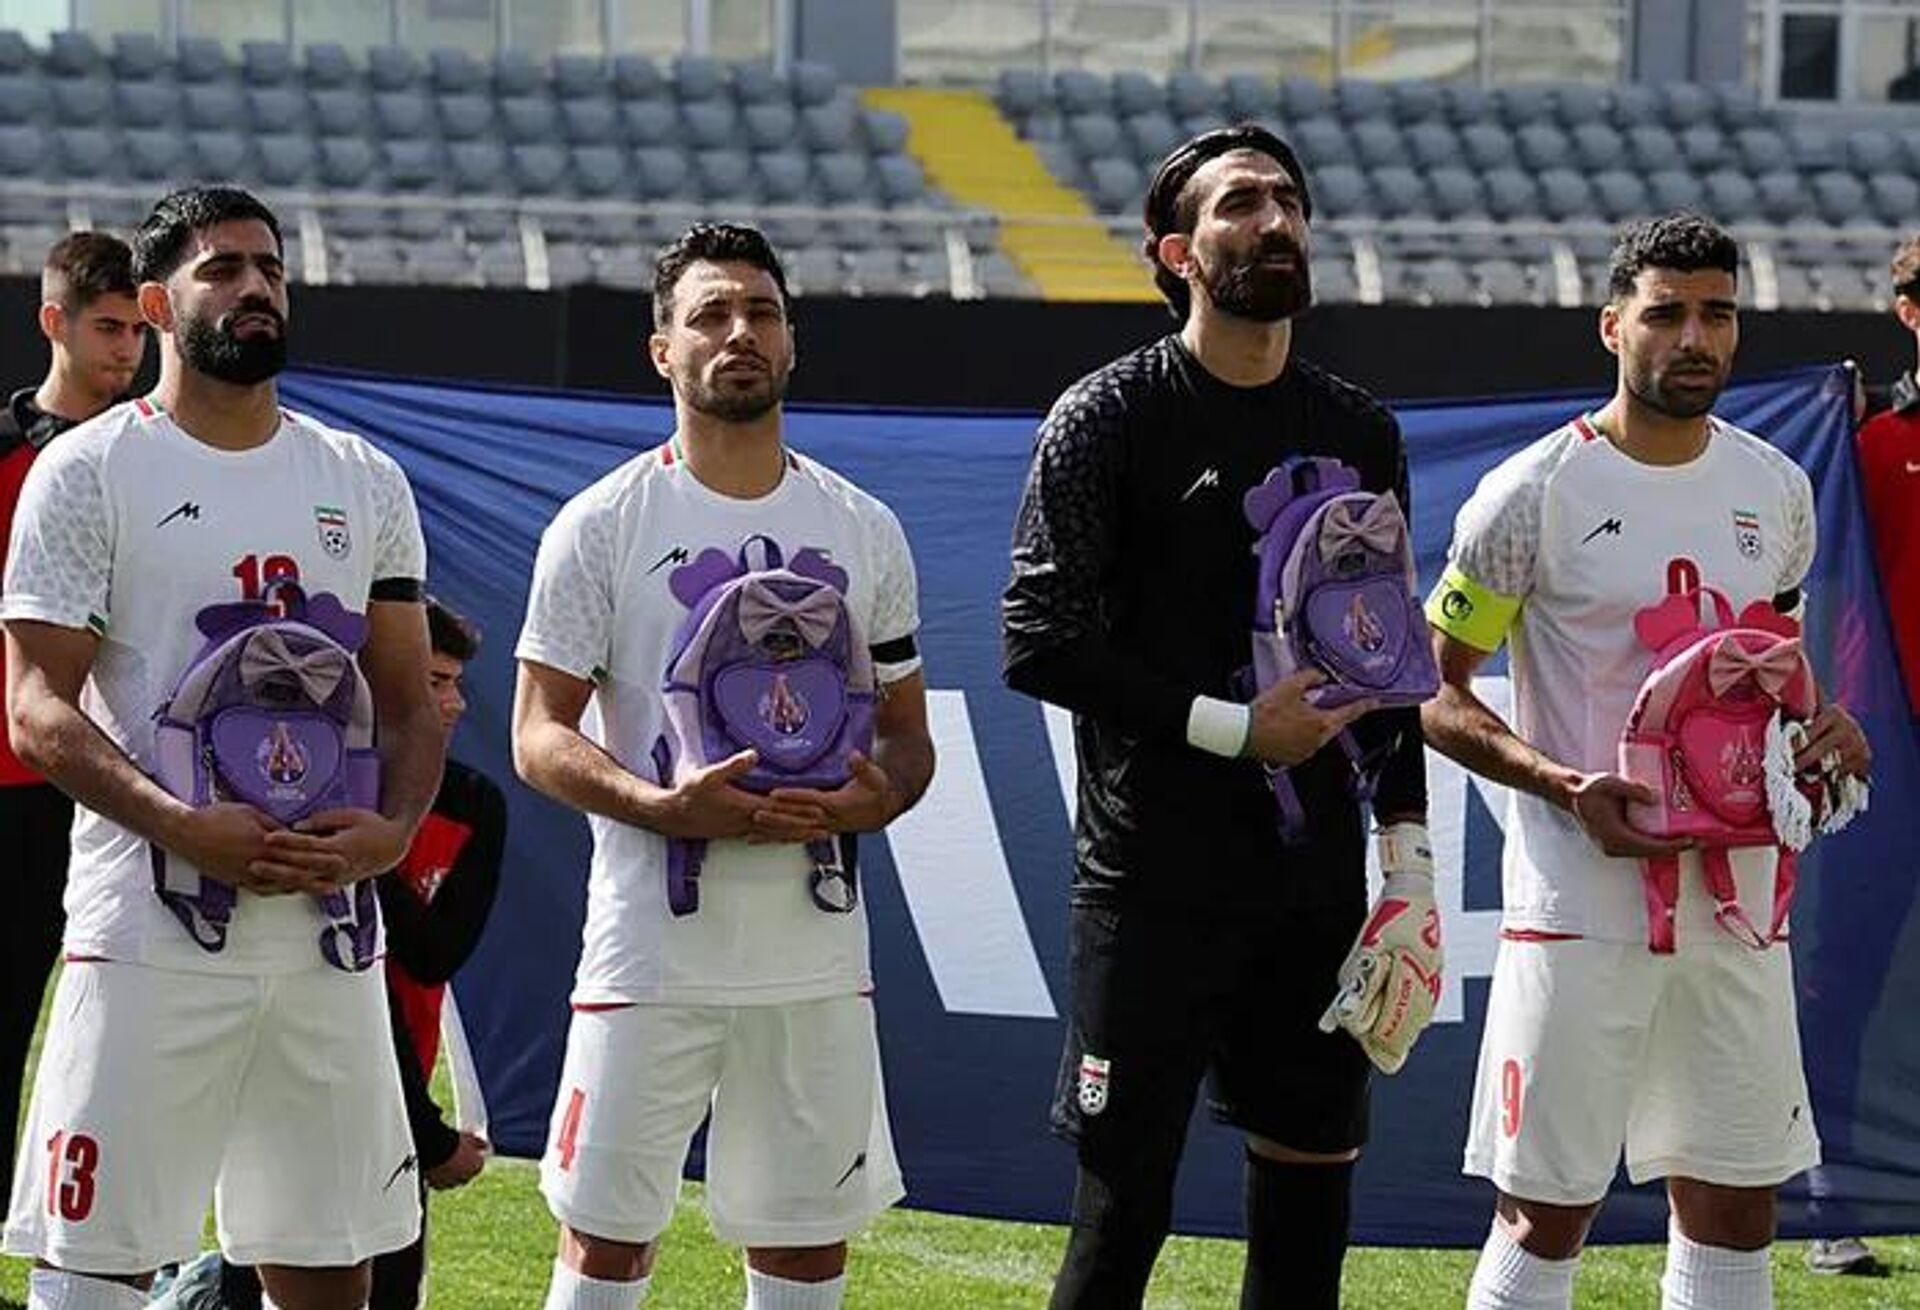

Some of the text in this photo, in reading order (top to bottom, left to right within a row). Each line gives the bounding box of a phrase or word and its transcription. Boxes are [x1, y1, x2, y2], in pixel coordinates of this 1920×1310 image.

[557, 1087, 585, 1172] 4
[1502, 1059, 1521, 1138] 9
[47, 1130, 98, 1222] 13
